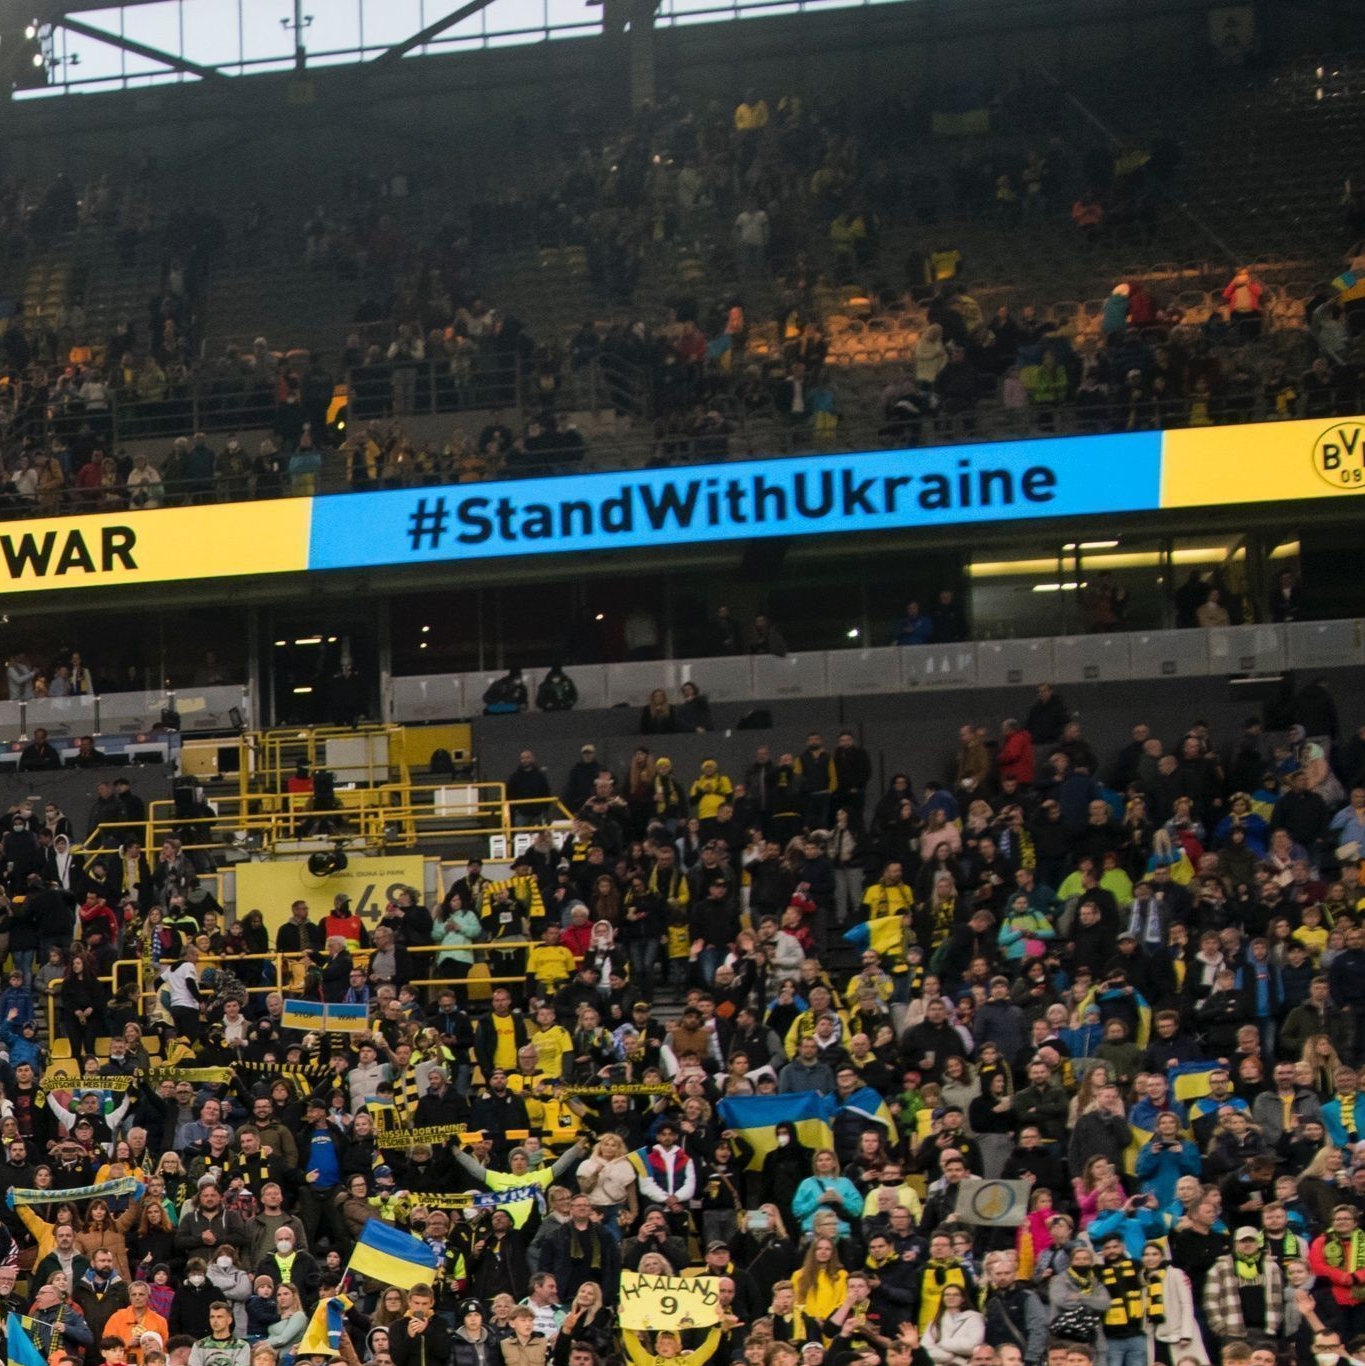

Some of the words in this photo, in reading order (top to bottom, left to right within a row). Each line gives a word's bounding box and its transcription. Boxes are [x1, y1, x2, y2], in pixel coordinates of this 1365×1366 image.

[1324, 429, 1365, 470] BV
[409, 460, 1055, 549] #StandWithUkraine
[0, 527, 137, 578] WAR
[481, 1187, 532, 1205] KYIV
[622, 1273, 718, 1306] HAALAND
[660, 1296, 679, 1315] 9
